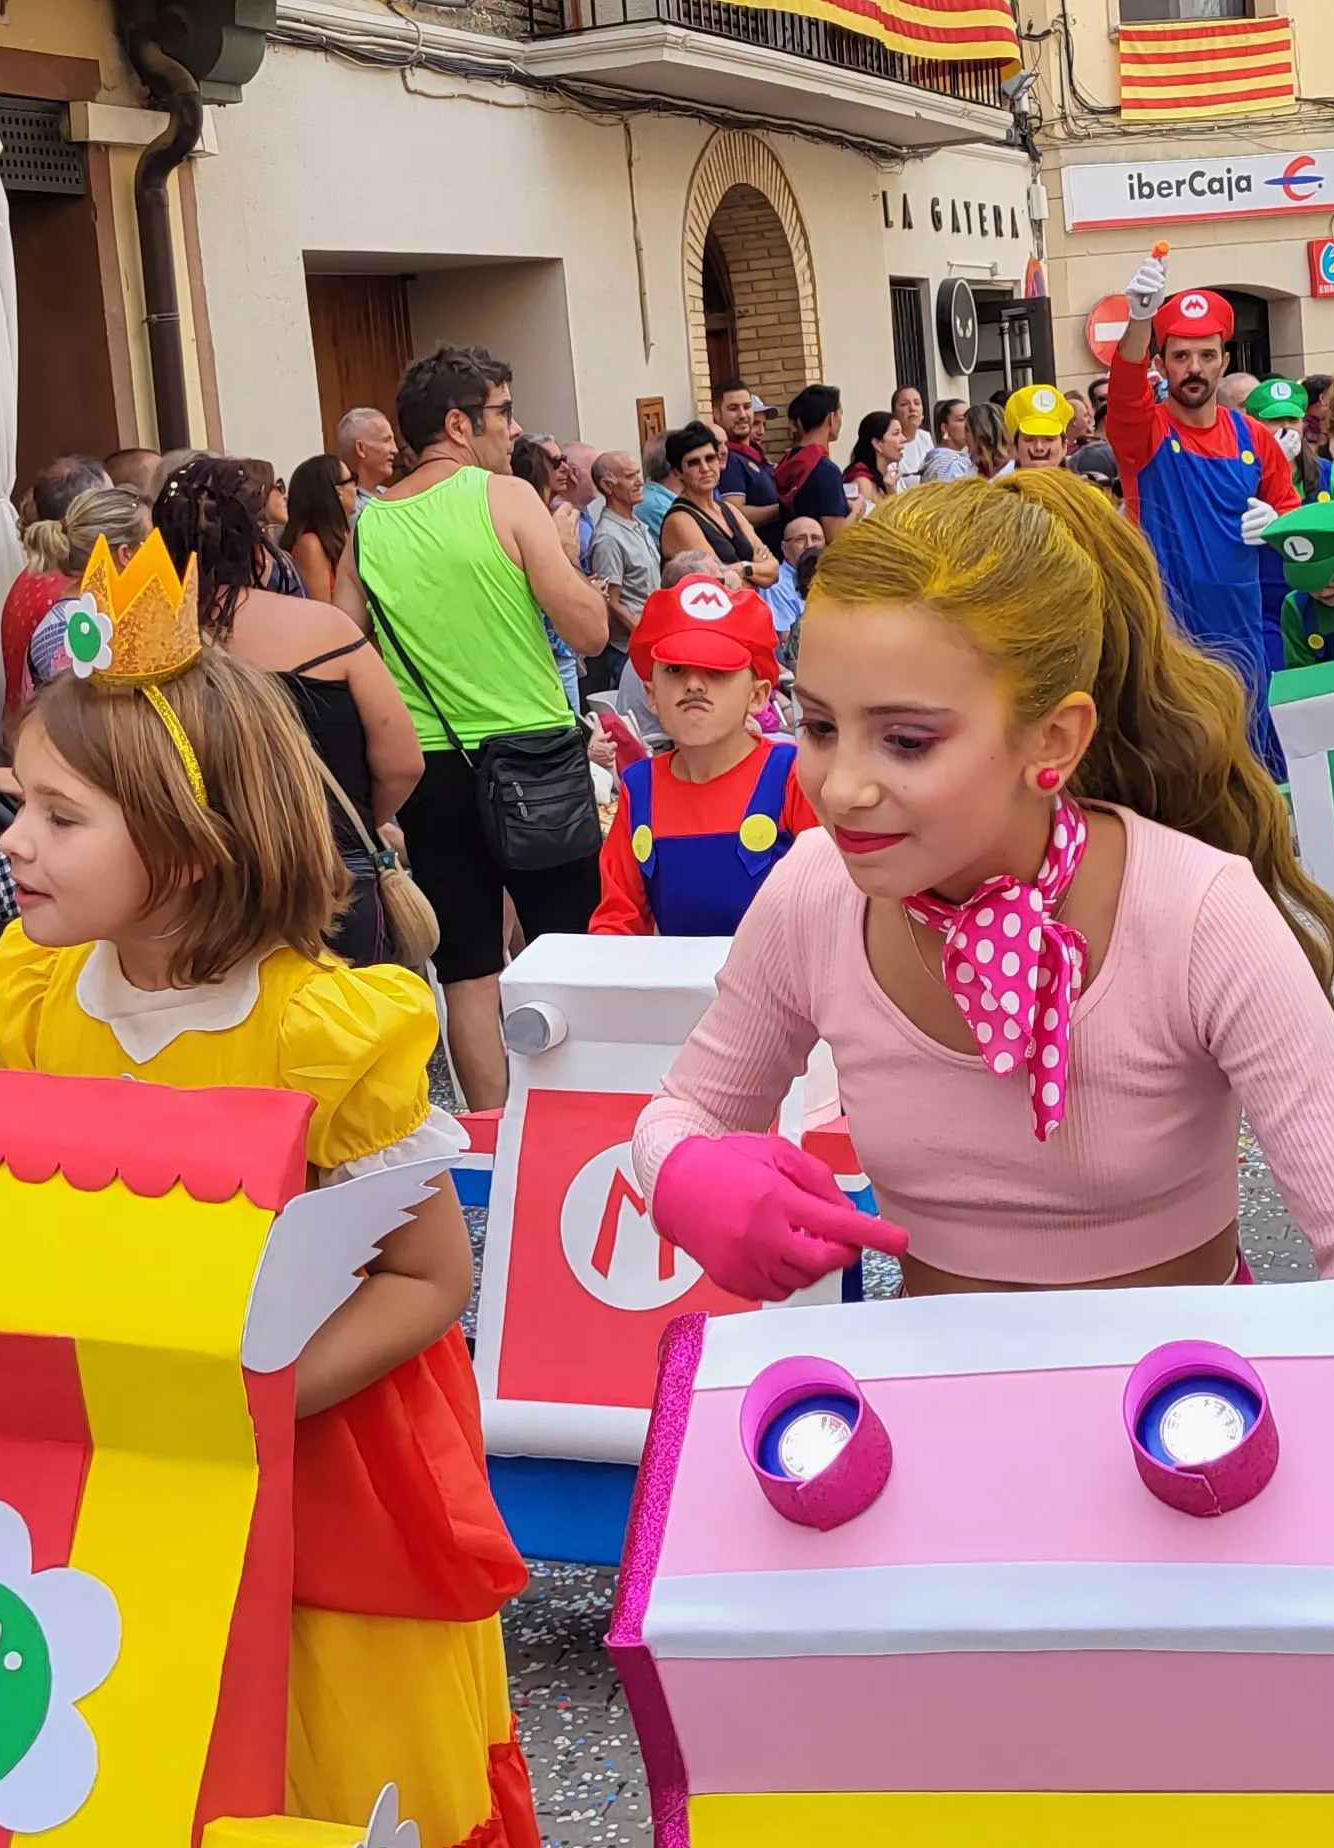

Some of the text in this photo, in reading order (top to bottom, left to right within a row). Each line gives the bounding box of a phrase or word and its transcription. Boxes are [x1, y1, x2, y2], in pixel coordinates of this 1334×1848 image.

[1127, 167, 1252, 201] iberCaja
[881, 190, 1020, 239] LA GATERA
[1184, 298, 1205, 311] M
[1289, 541, 1309, 557] L
[689, 589, 725, 608] M
